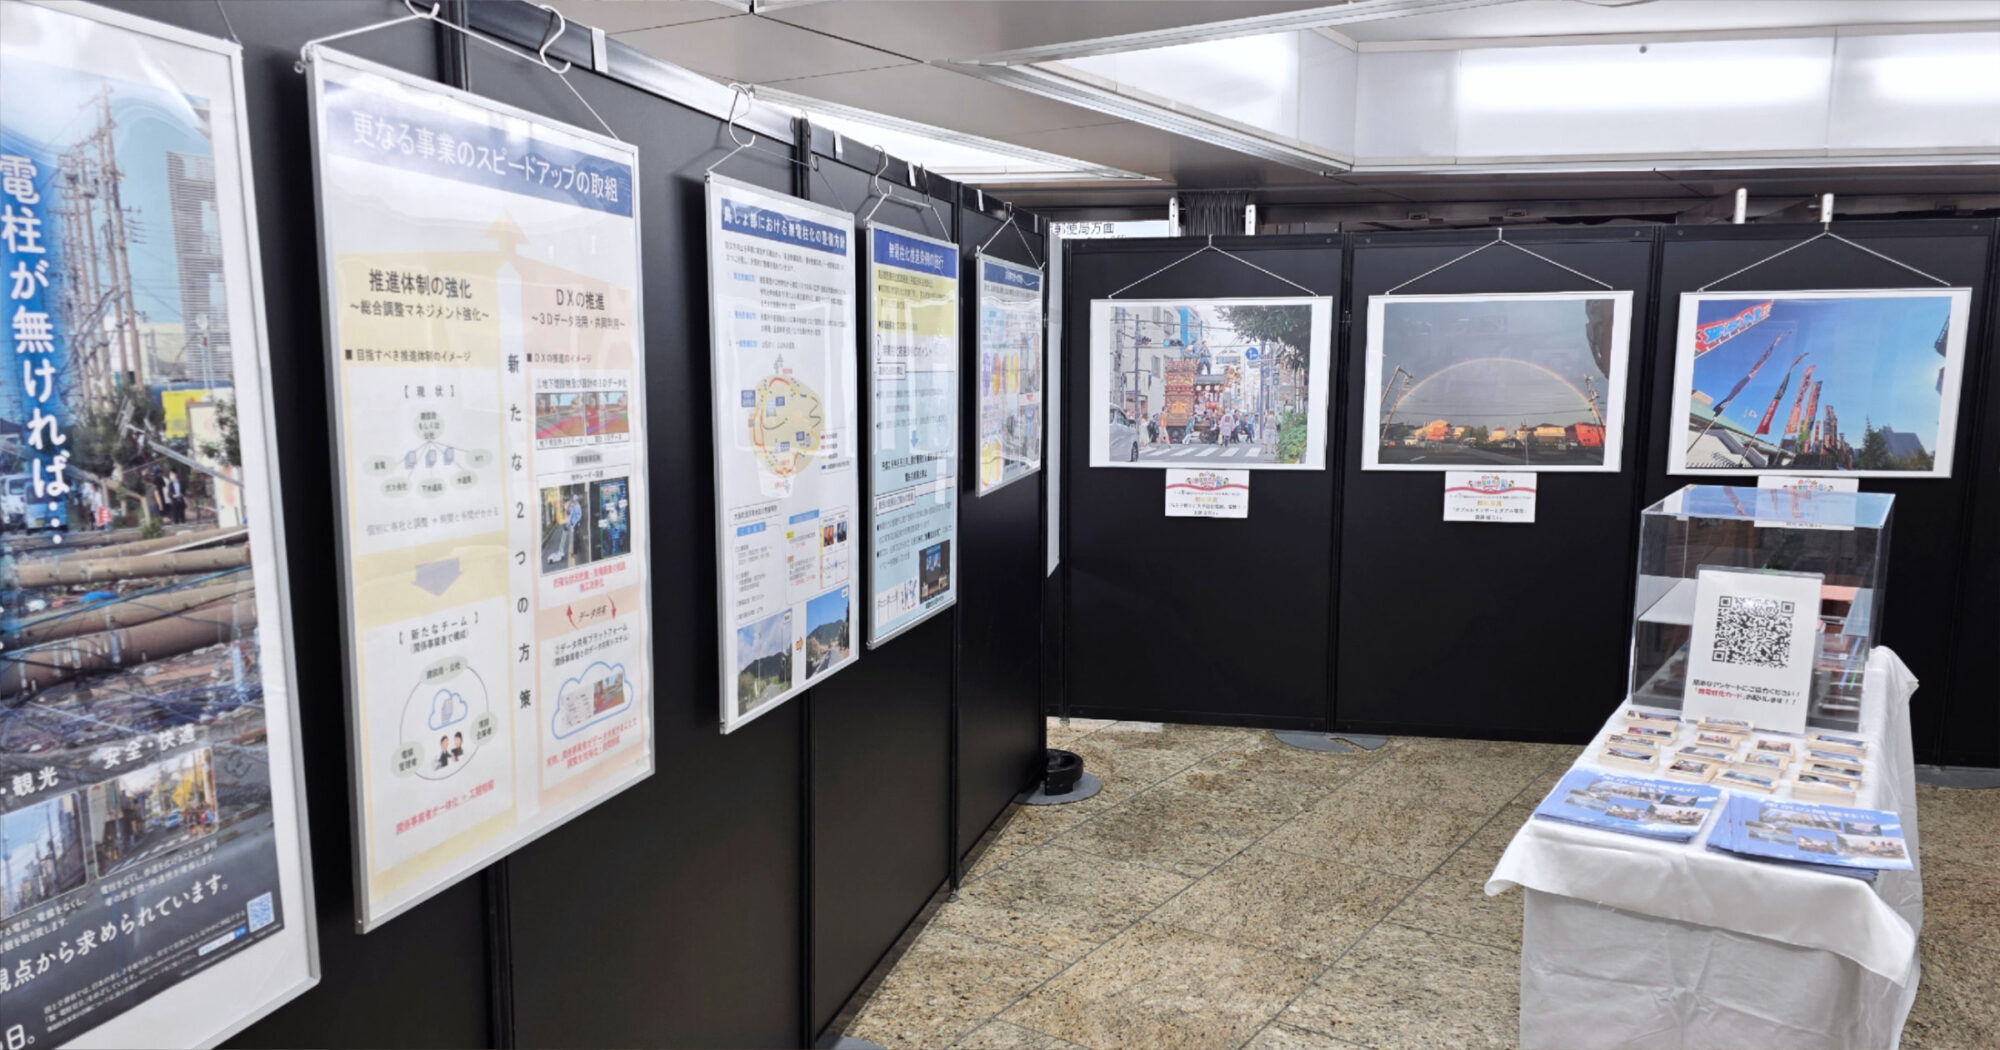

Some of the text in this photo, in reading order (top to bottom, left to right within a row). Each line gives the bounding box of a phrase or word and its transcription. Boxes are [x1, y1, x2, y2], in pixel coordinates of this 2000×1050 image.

[352, 110, 618, 203] 更なる事業のスピードアップの取組
[724, 206, 846, 250] 島しょ部における無電柱化の整備方針
[368, 268, 472, 300] 推進体制の強化
[555, 288, 606, 311] DXの推進
[103, 723, 196, 770] 安全・快適
